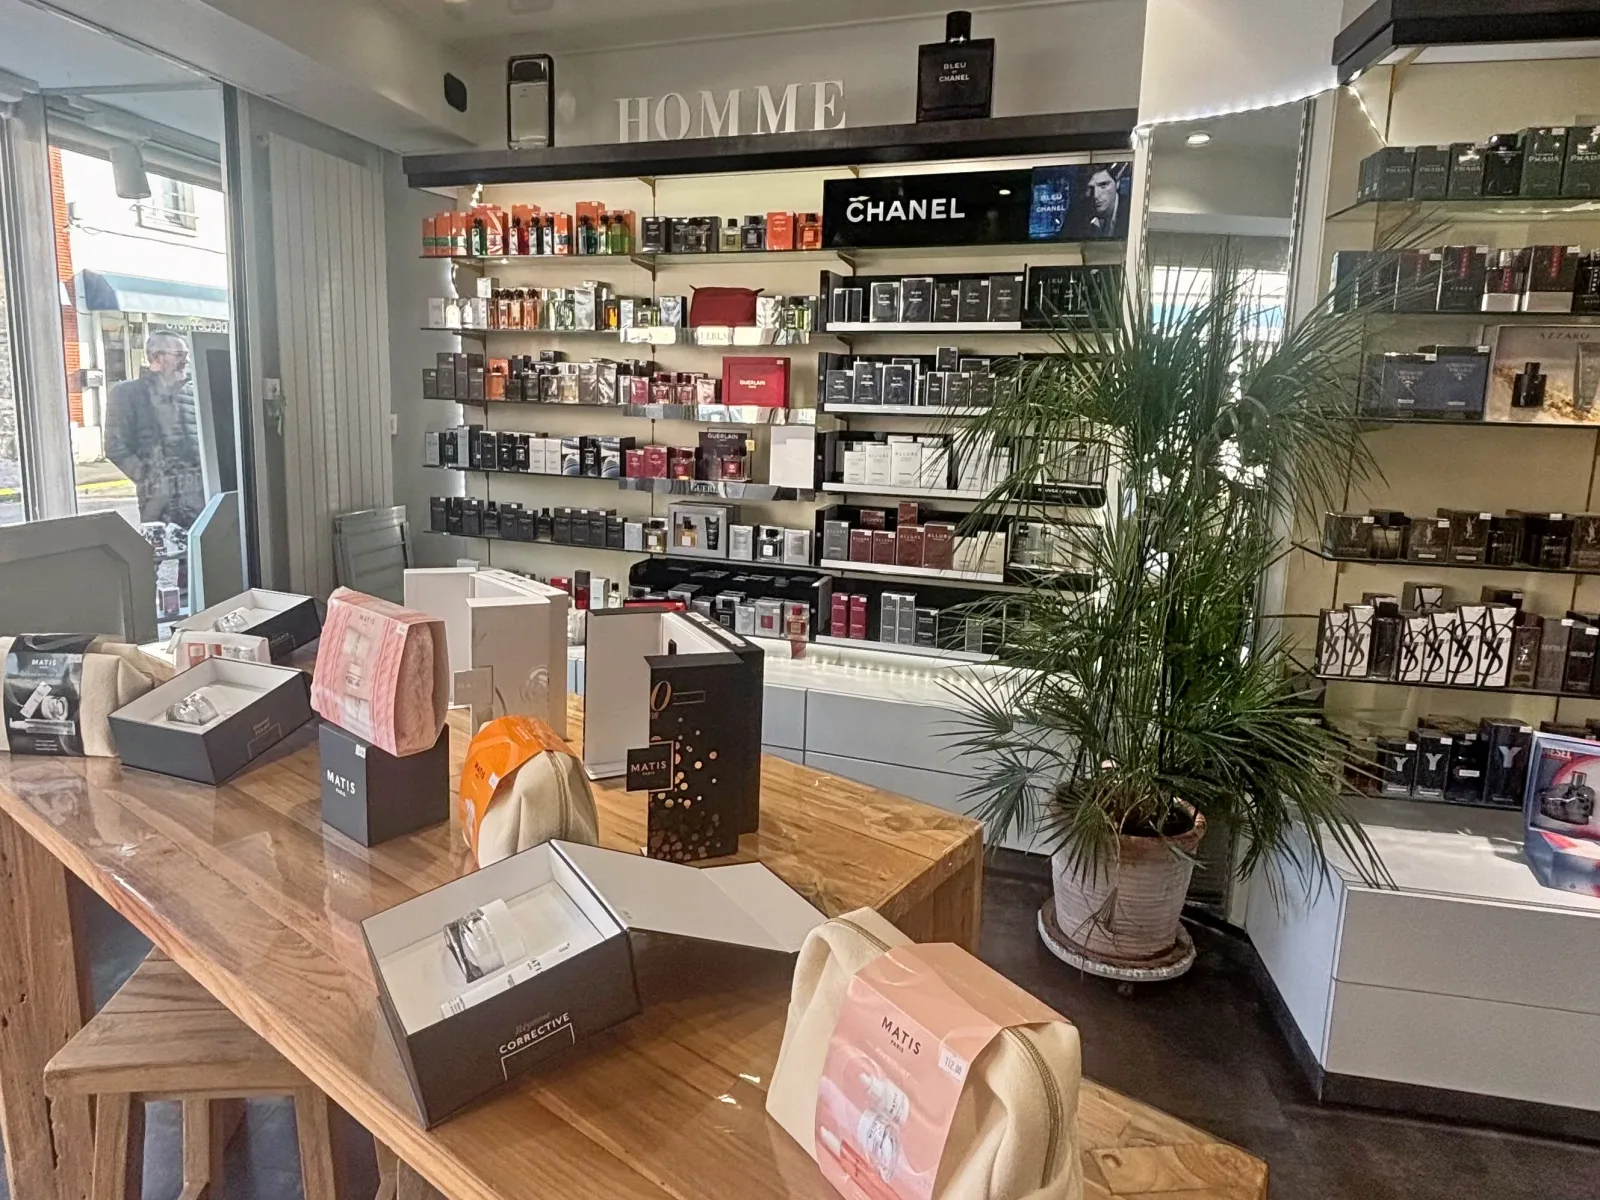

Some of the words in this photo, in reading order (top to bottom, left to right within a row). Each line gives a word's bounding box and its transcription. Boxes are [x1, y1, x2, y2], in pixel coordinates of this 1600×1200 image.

[943, 61, 967, 70] BLEU
[938, 73, 970, 82] CHANEL
[614, 80, 847, 144] HOMME
[845, 197, 966, 223] CHANEL
[1035, 204, 1066, 213] CHANEL
[739, 379, 766, 387] GUERLAIN
[707, 432, 739, 440] GUERLAIN
[31, 658, 57, 667] MATIS
[1394, 756, 1408, 772] Y
[1425, 752, 1443, 771] Y
[1499, 745, 1521, 769] Y
[630, 760, 667, 773] MATIS
[326, 769, 356, 795] MATIS
[499, 1012, 571, 1054] CORRECTIVE
[880, 1016, 923, 1056] MATIS
[890, 1038, 905, 1054] PARIS
